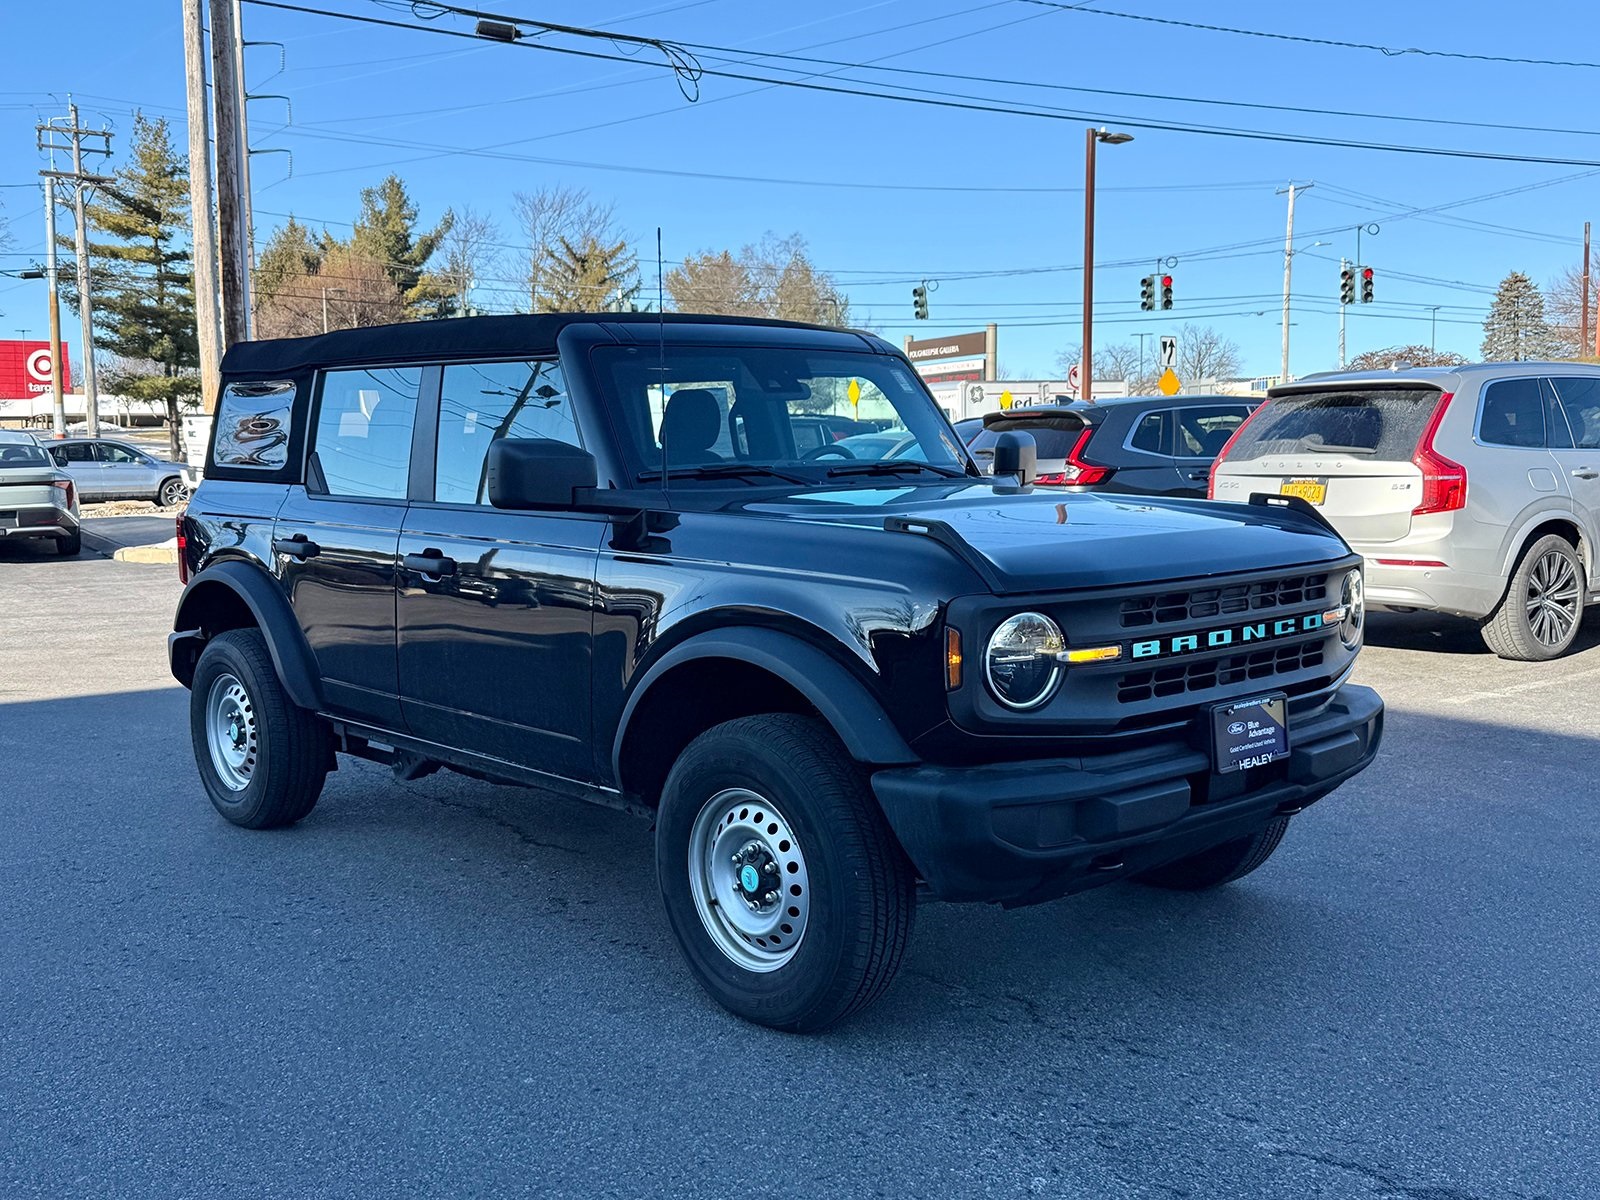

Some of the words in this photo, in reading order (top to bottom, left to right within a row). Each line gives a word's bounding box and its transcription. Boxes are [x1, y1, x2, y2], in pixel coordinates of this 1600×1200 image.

[1261, 461, 1344, 469] VOLVO
[1132, 613, 1322, 658] BRONCO
[1247, 721, 1260, 730] Blue
[1248, 726, 1275, 738] Advantage
[1239, 752, 1273, 770] HEALEY
